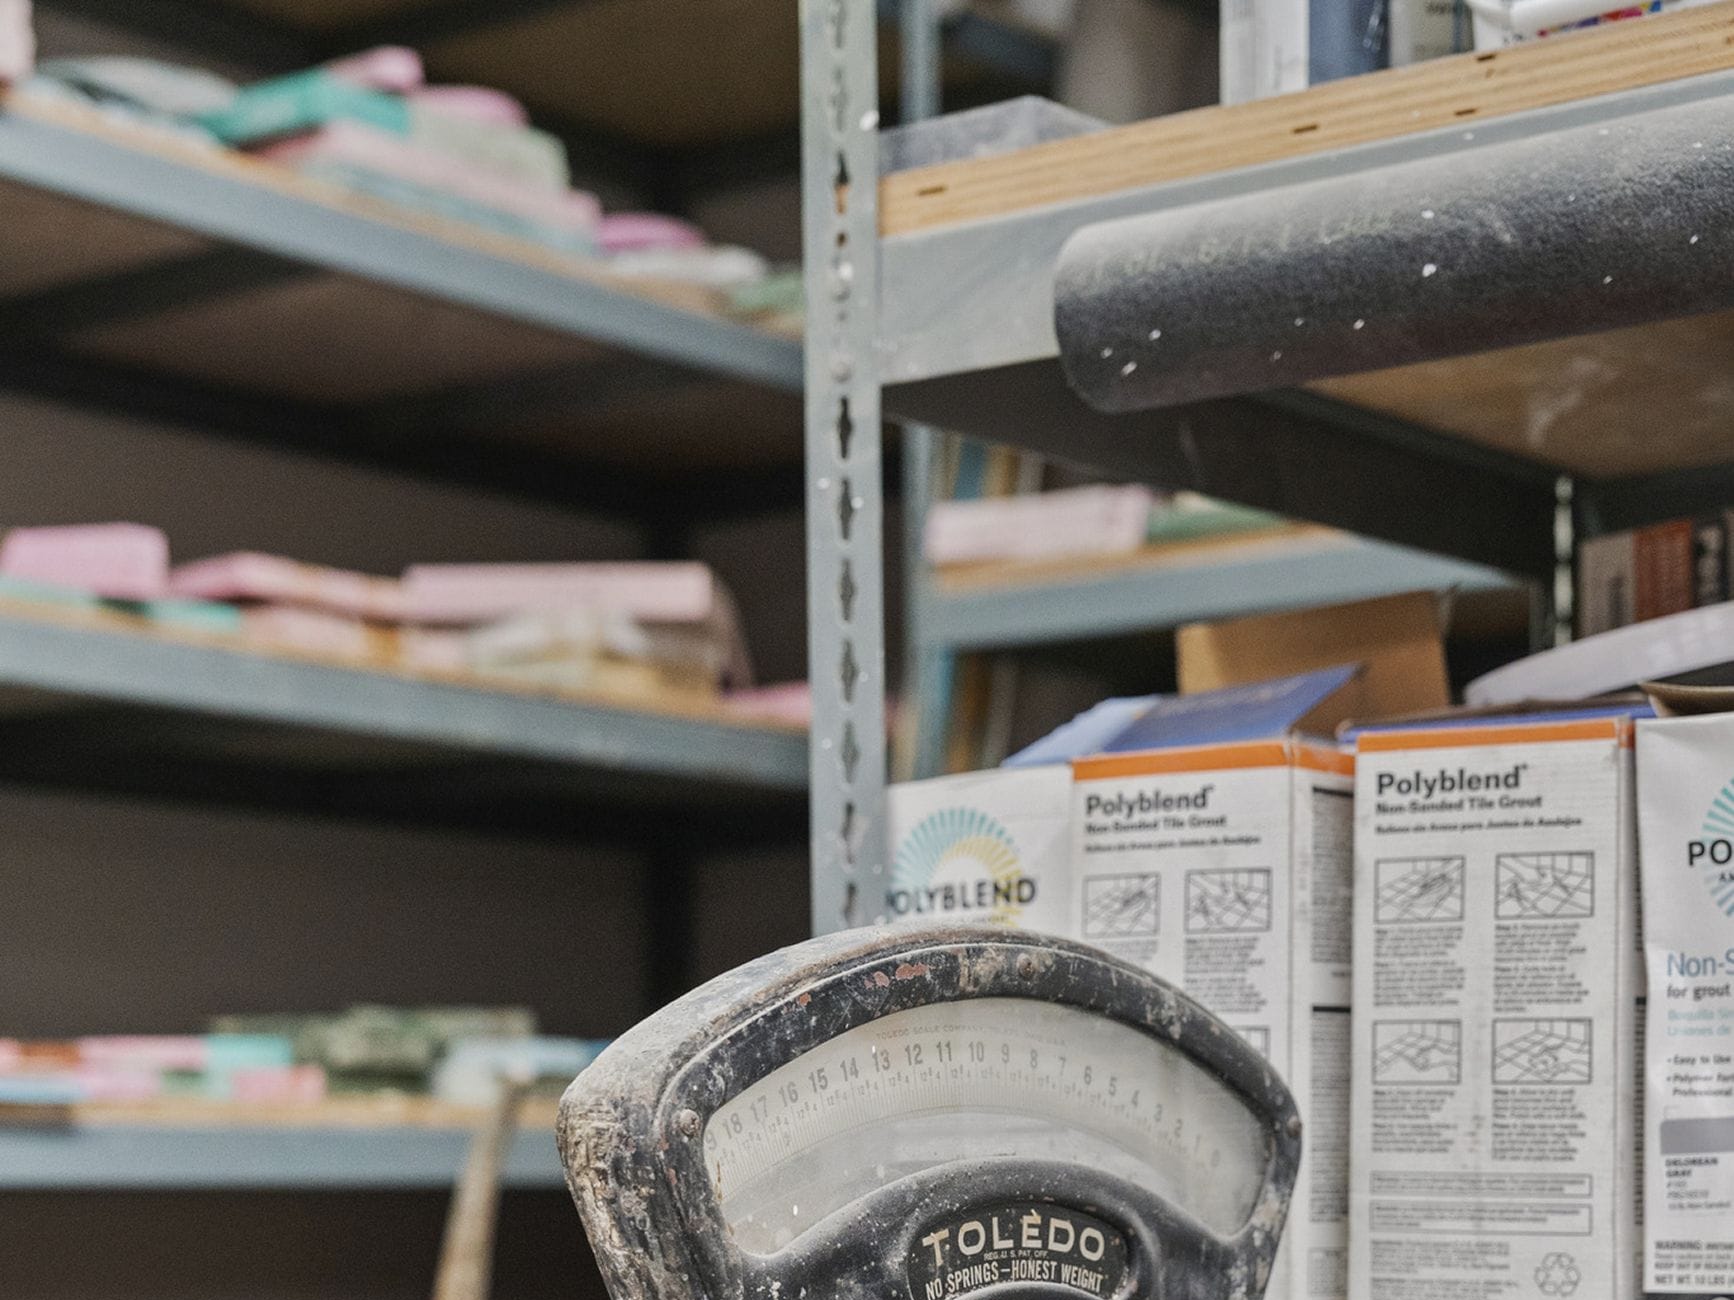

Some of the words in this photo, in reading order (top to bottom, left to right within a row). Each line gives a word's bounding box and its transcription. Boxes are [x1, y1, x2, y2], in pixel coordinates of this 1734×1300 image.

[1375, 766, 1521, 799] Polyblend
[1086, 786, 1209, 819] Polyblend
[1666, 983, 1687, 999] for
[1693, 982, 1731, 1002] grout
[722, 1112, 743, 1139] 18
[750, 1094, 768, 1122] 17
[778, 1080, 799, 1107] 16
[808, 1067, 828, 1093] 15
[839, 1057, 859, 1082] 14
[872, 1049, 890, 1073] 13
[904, 1043, 924, 1066] 12
[936, 1041, 952, 1063] 11
[968, 1041, 984, 1063] 10
[1002, 1043, 1010, 1064] 9
[1030, 1048, 1038, 1069] 8
[1057, 1056, 1066, 1076] 7
[1084, 1065, 1092, 1086] 6
[1109, 1076, 1118, 1096] 5
[1131, 1090, 1140, 1109] 4
[1174, 1118, 1183, 1139] 2
[922, 1213, 1105, 1267] TOLEDO
[1061, 1263, 1104, 1293] WEIGHT
